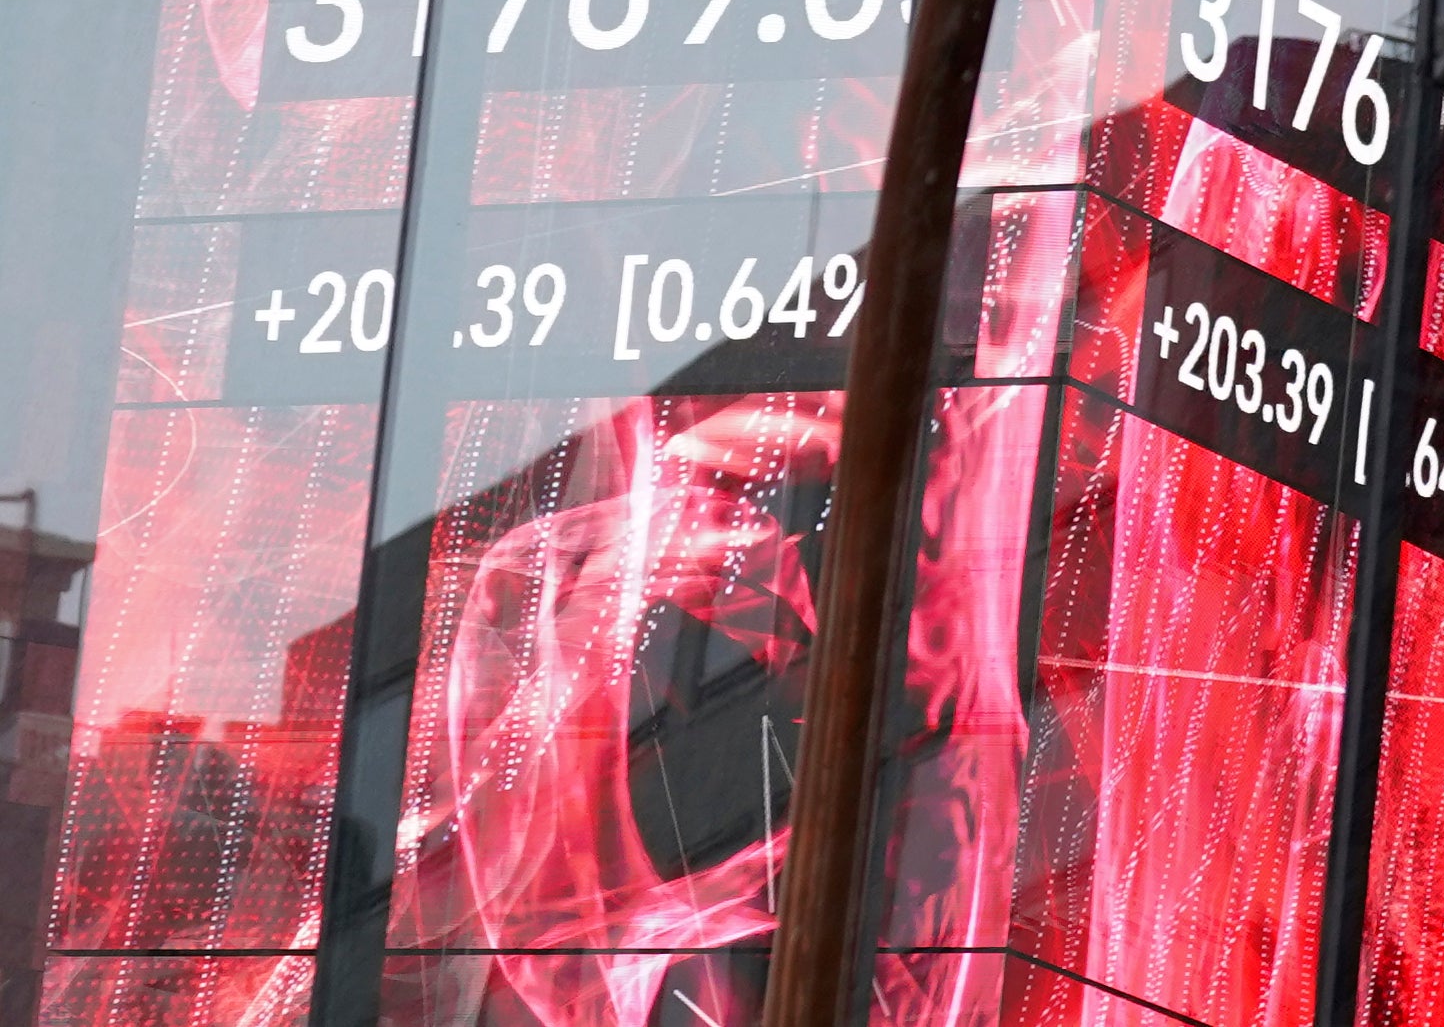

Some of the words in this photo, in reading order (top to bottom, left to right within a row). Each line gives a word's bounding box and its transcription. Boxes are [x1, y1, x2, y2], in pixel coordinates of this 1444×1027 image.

[254, 262, 567, 354] +20.39
[613, 253, 867, 361] [0.64%
[1153, 302, 1333, 445] +203.39
